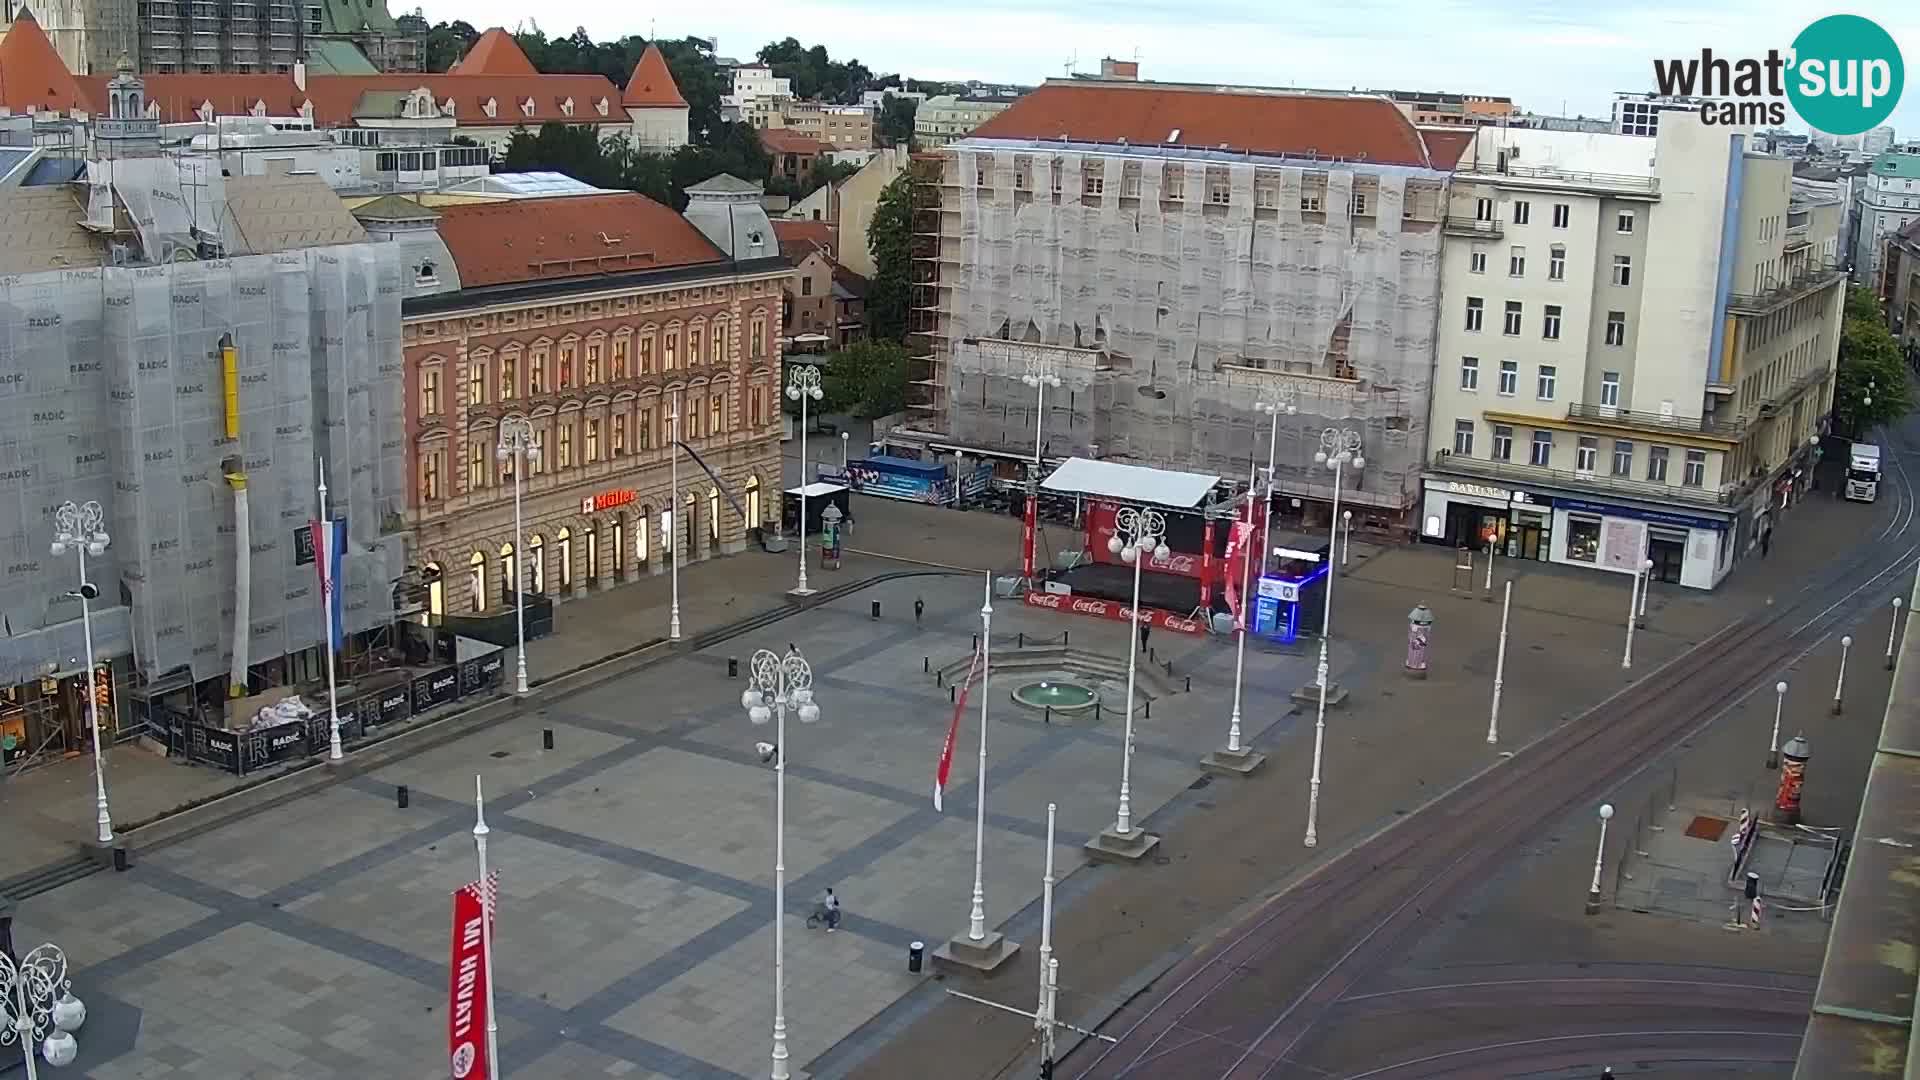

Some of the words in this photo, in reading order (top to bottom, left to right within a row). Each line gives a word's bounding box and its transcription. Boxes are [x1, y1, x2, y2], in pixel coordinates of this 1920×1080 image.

[596, 489, 638, 510] Müller
[463, 917, 482, 950] MI
[455, 954, 479, 1037] HRVATI
